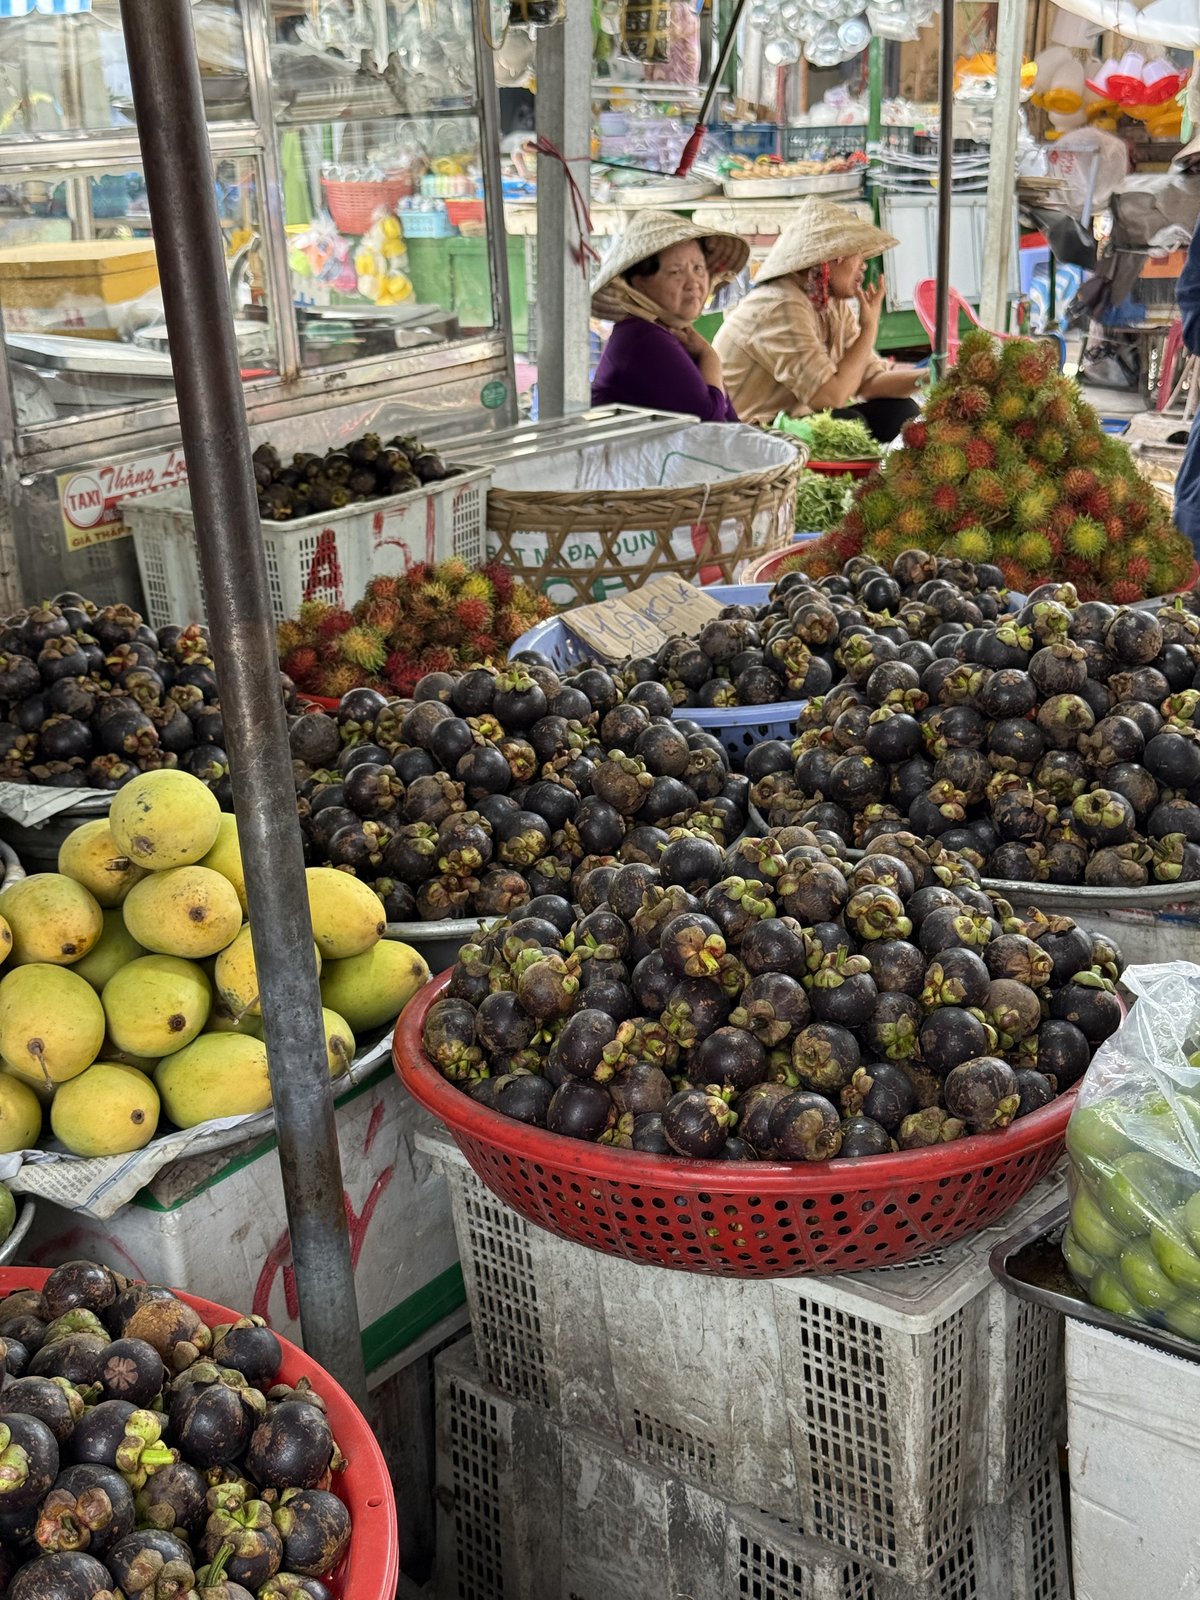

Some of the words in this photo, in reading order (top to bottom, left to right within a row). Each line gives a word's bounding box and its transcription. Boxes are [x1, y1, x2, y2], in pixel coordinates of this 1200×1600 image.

[161, 452, 187, 479] Lo
[70, 489, 101, 512] TAXI
[486, 545, 526, 565] BT
[567, 543, 598, 562] ĐA
[613, 529, 673, 557] DỤN
